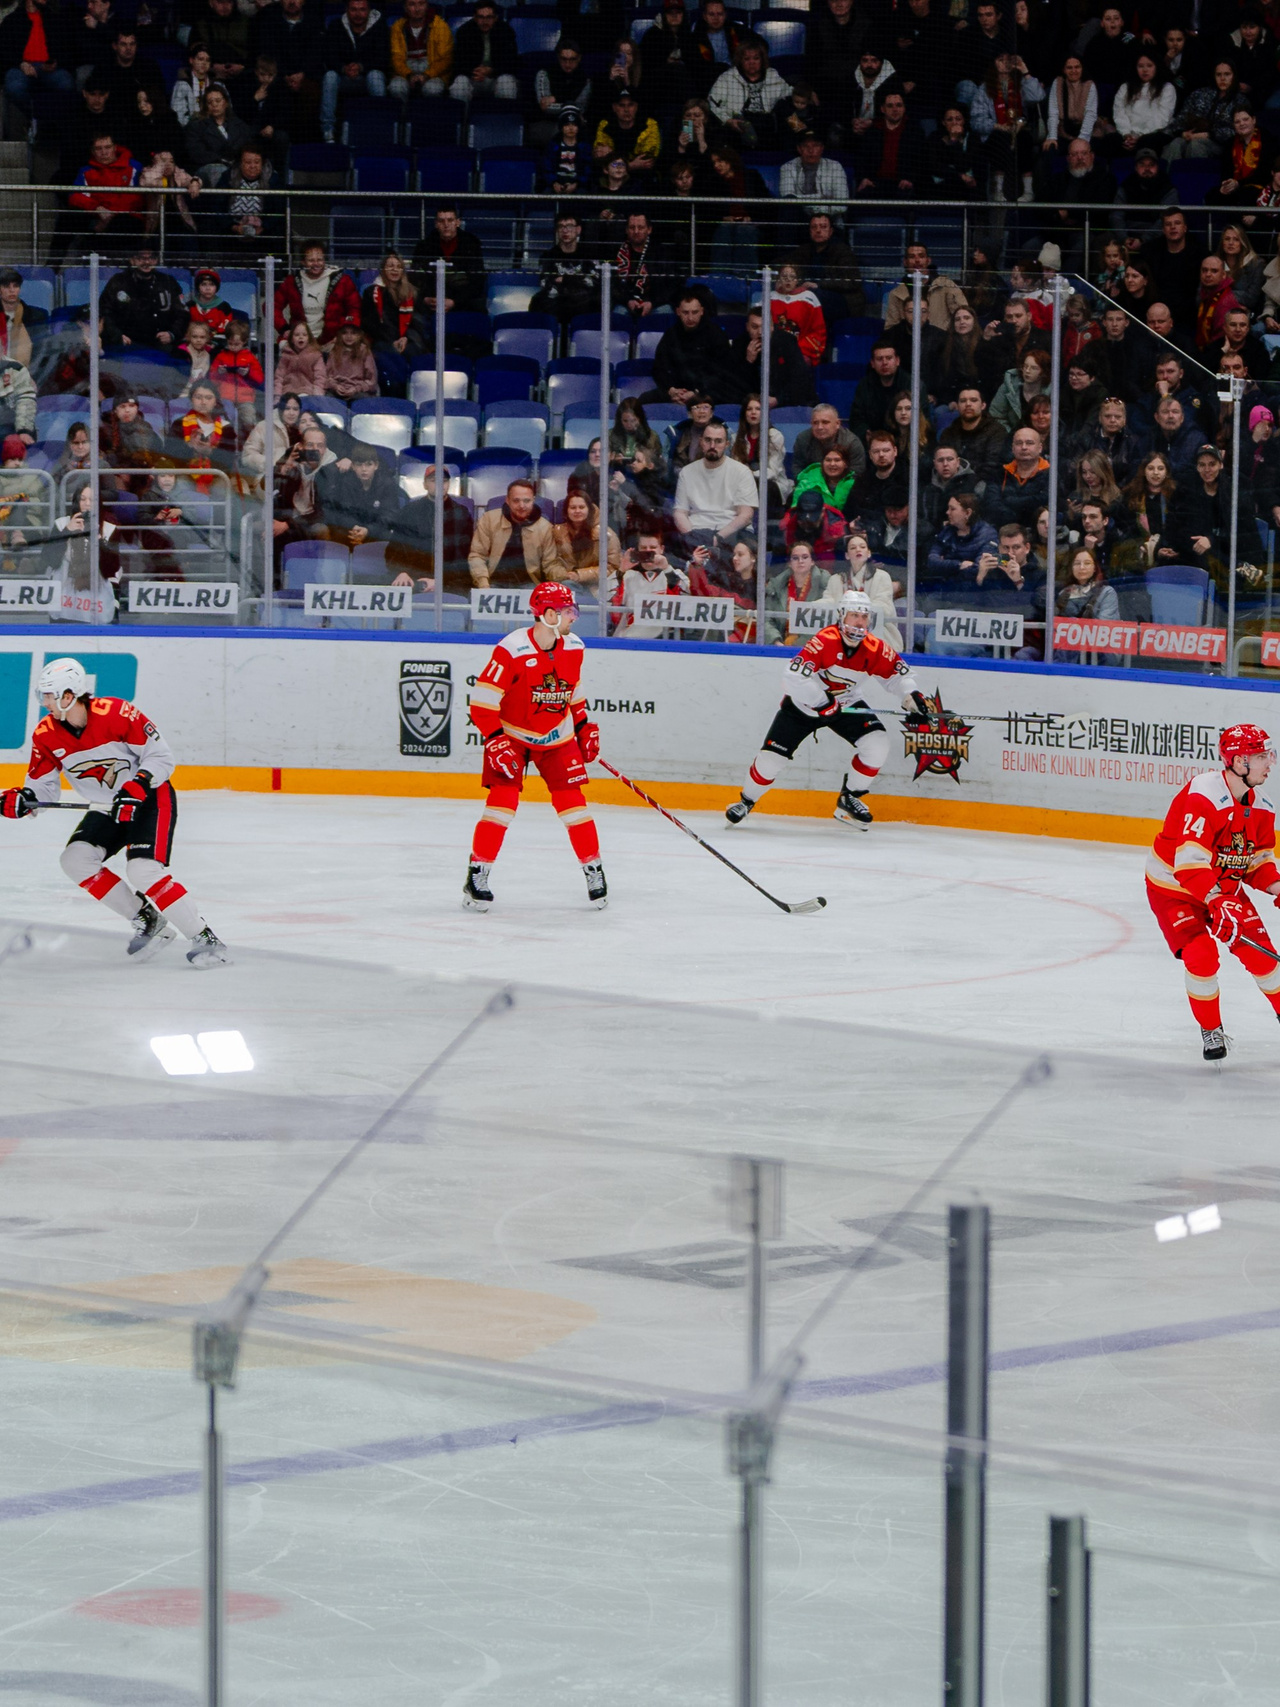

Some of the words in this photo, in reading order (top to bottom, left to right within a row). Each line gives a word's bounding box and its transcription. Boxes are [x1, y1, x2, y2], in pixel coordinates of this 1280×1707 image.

[136, 587, 231, 608] KHL.RU
[310, 590, 405, 612] KHL.RU
[478, 594, 532, 615] KHL.
[641, 598, 730, 627] KHL.RU
[941, 615, 1019, 641] KHL.RU
[1054, 622, 1137, 649] FONBET
[1141, 629, 1225, 657] FONBET
[403, 663, 449, 675] FONBET
[789, 656, 816, 677] 86
[402, 743, 448, 754] 2024/2025
[900, 731, 975, 763] REDSTAR
[1002, 710, 1222, 762] 北京昆仑鸿星冰球俱乐
[1002, 750, 1047, 774] BEIJING
[1050, 754, 1095, 779] KUNLUN
[1099, 758, 1122, 781] RED
[1125, 761, 1155, 783] STAR
[1183, 813, 1206, 839] 24
